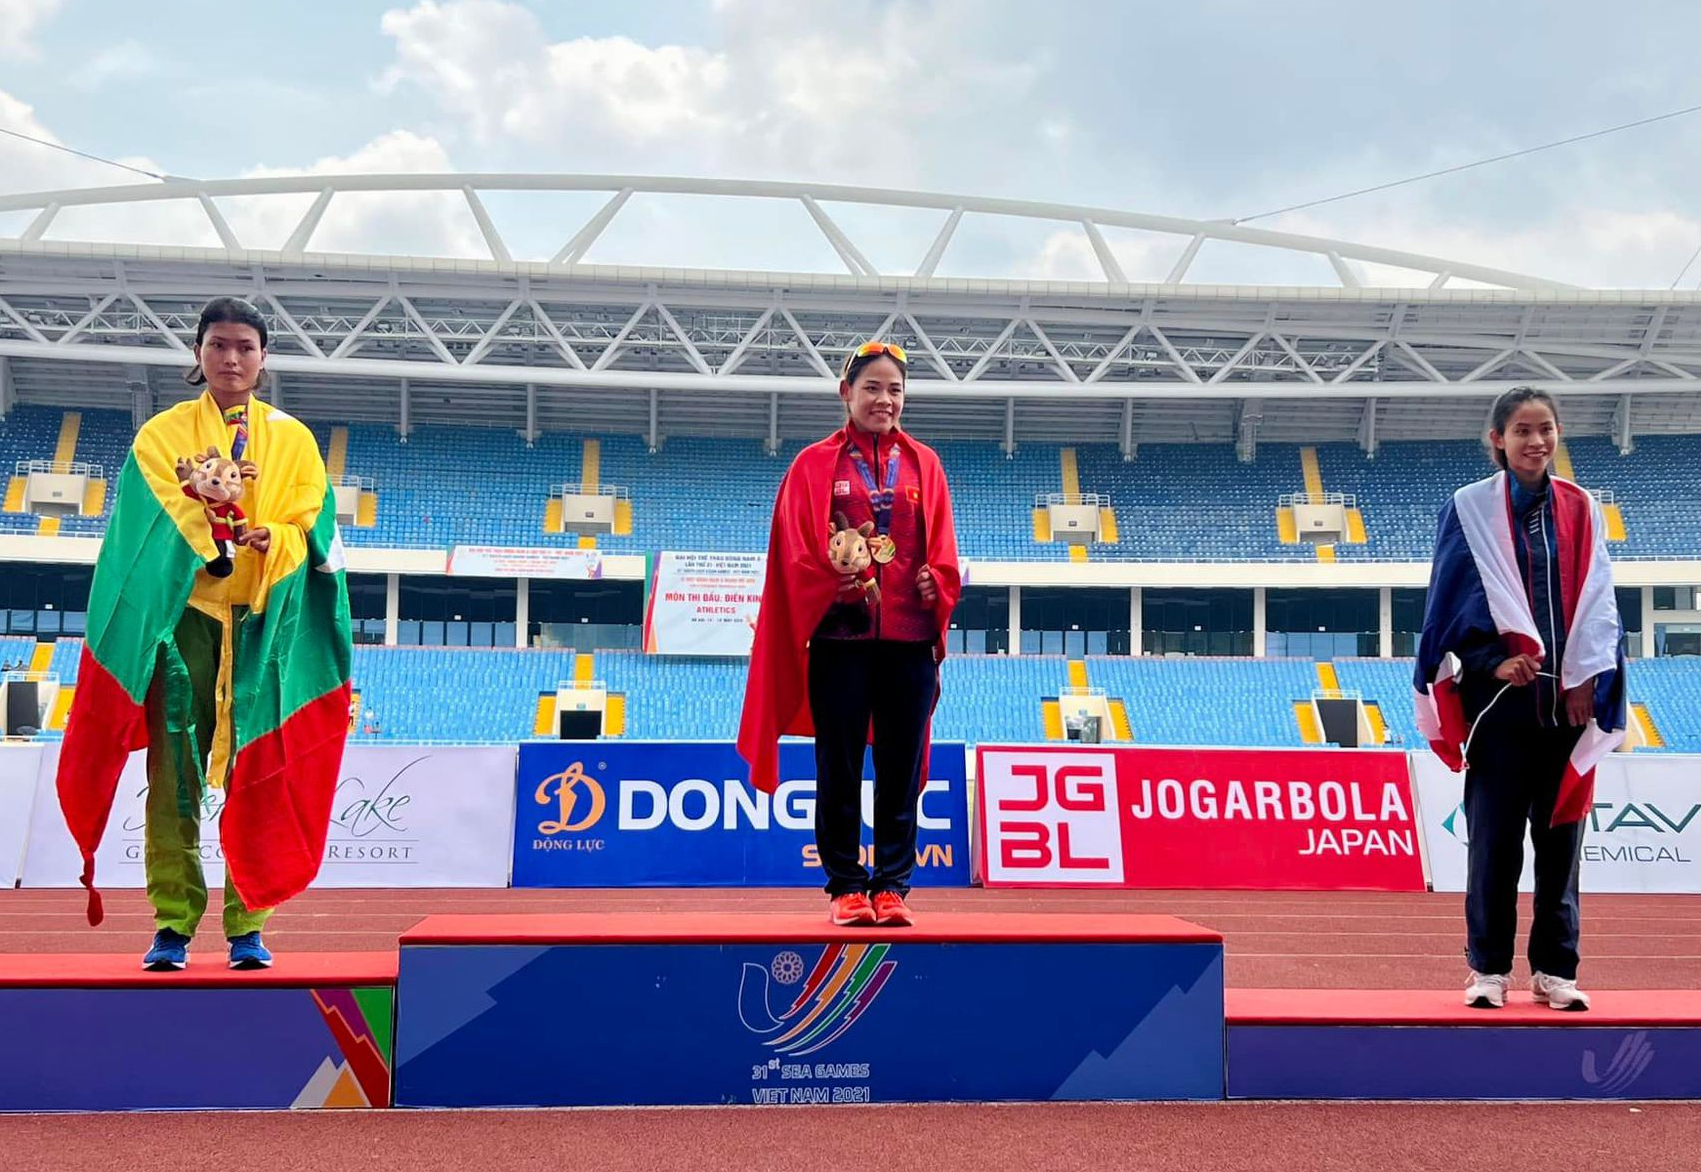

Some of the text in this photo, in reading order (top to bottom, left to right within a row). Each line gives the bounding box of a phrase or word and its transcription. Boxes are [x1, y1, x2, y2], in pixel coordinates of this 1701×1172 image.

[665, 592, 685, 602] MÔN
[688, 594, 700, 602] THI
[747, 595, 762, 604] KIN
[696, 606, 736, 614] ATHLETICS
[998, 764, 1105, 811] JG
[619, 779, 951, 830] DONGC
[1131, 779, 1408, 821] JOGARBOLA
[1590, 803, 1701, 833] TAV
[328, 845, 413, 859] RESORT
[533, 837, 605, 853] ĐỘNG LỰC
[1000, 821, 1109, 869] BL
[1298, 829, 1414, 857] JAPAN
[1583, 846, 1691, 862] EMICAL
[752, 1057, 870, 1080] 31st SEA GAMES
[752, 1086, 870, 1104] VIET NAM 2021
